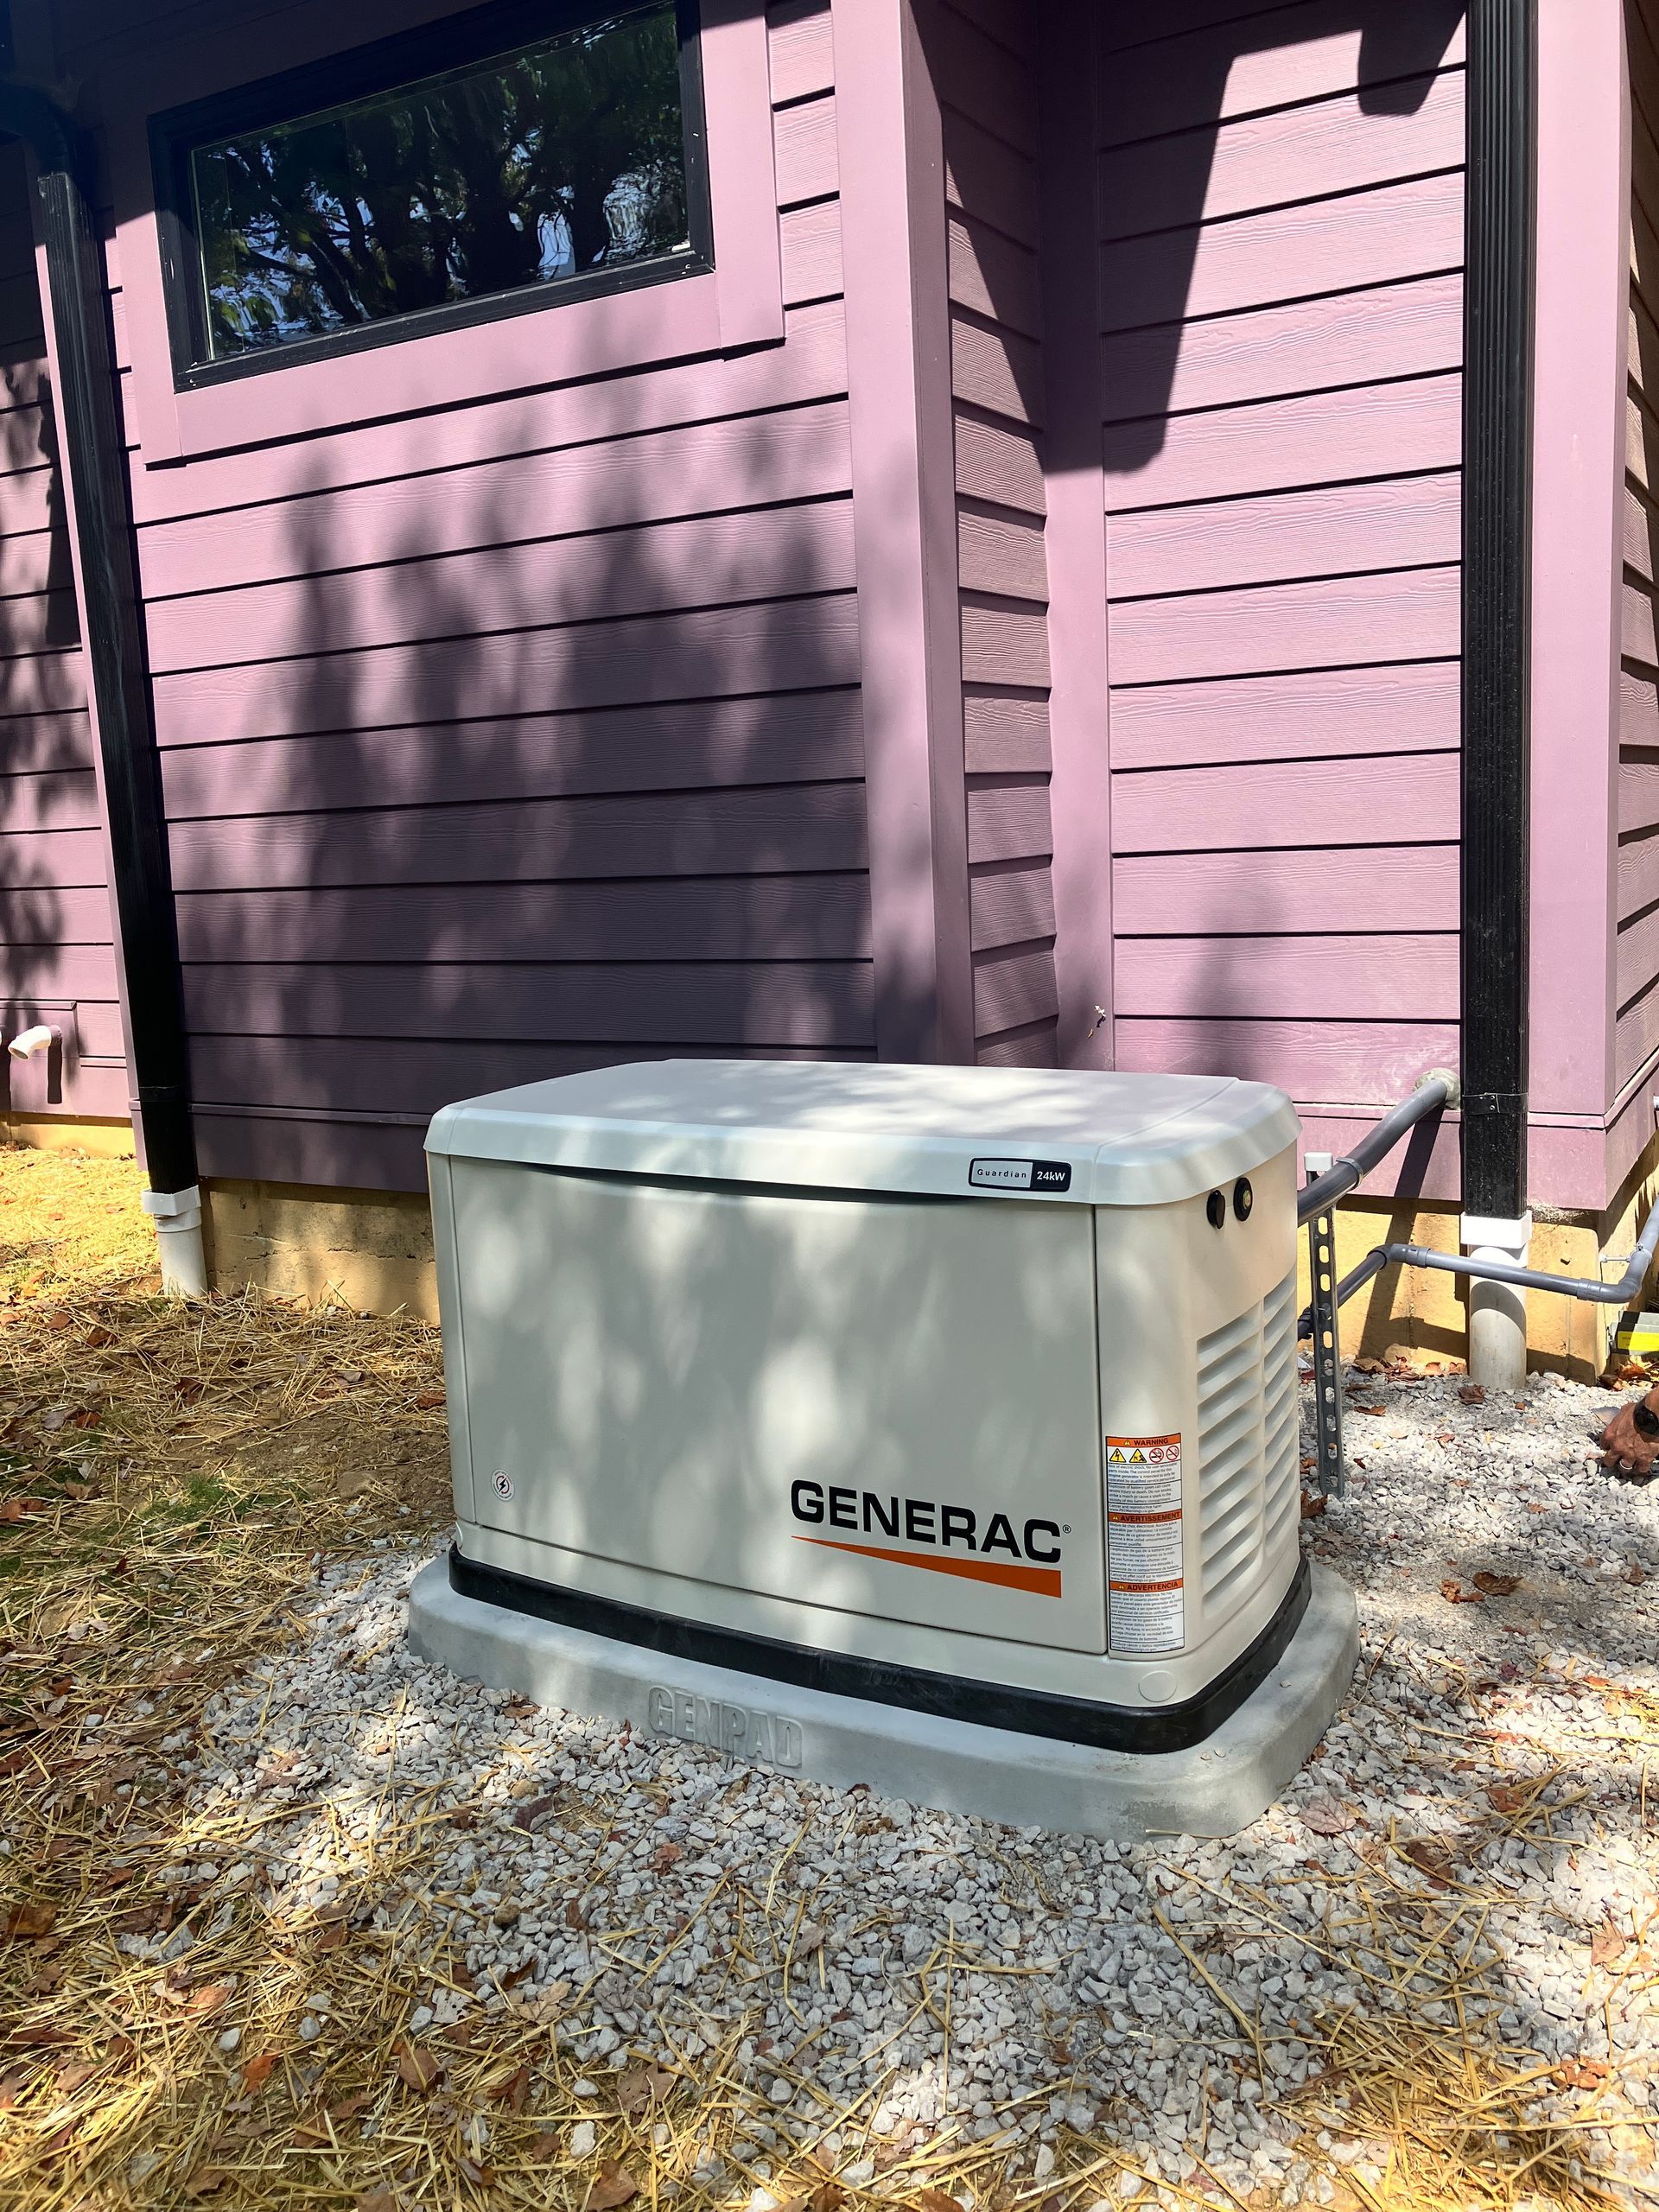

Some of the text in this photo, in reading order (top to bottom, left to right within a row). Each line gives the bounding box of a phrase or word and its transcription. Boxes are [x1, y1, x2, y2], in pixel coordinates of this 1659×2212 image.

[976, 1168, 1066, 1181] Guardian 24kW
[1134, 1438, 1169, 1446] WARNING
[1120, 1511, 1180, 1522] AVERTISSEMENT
[1127, 1581, 1179, 1592] ADVERTENCIA
[648, 1685, 804, 1769] GENPAD
